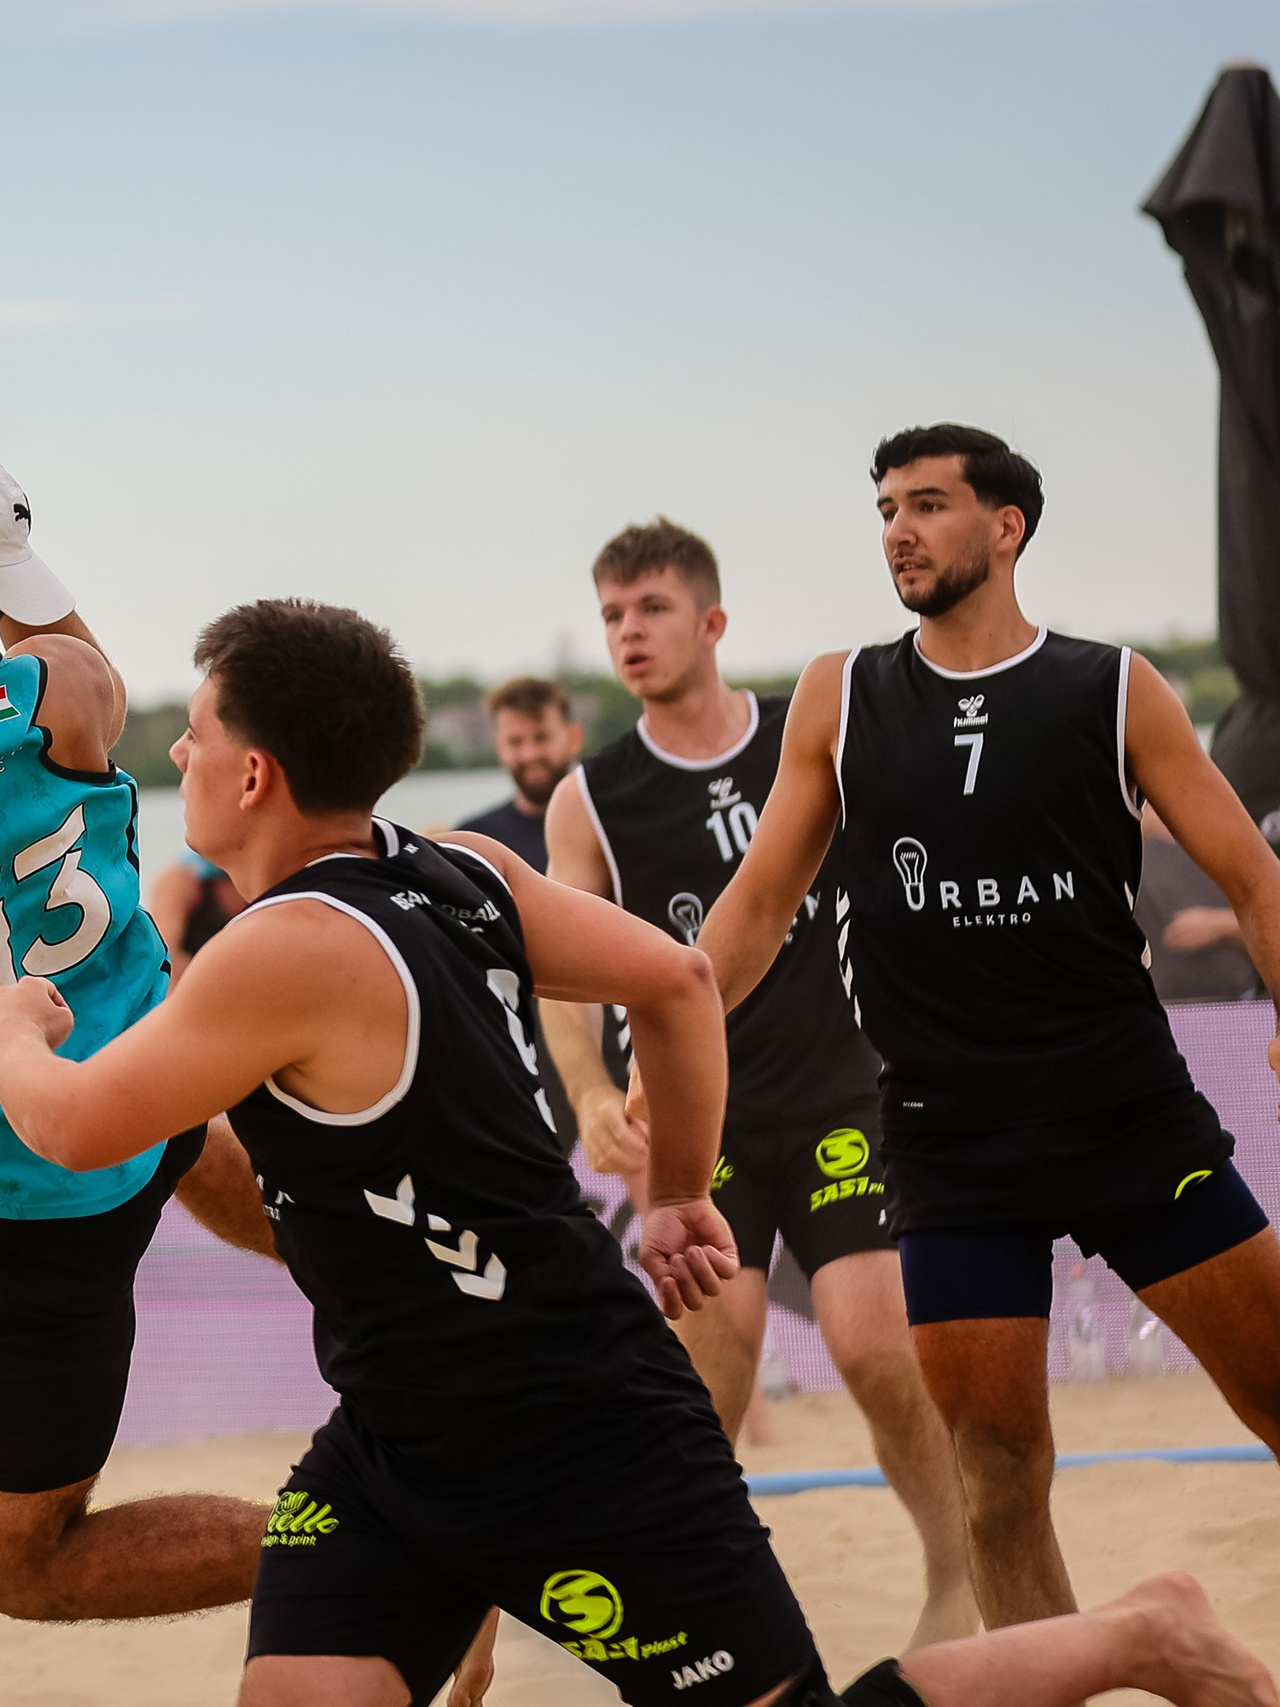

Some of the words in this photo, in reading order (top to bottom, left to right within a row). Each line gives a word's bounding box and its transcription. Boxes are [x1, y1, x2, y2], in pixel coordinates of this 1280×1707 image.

[954, 732, 984, 796] 7
[705, 801, 759, 863] 10
[952, 912, 1032, 928] ELEKTRO
[671, 1650, 735, 1690] JAKO
